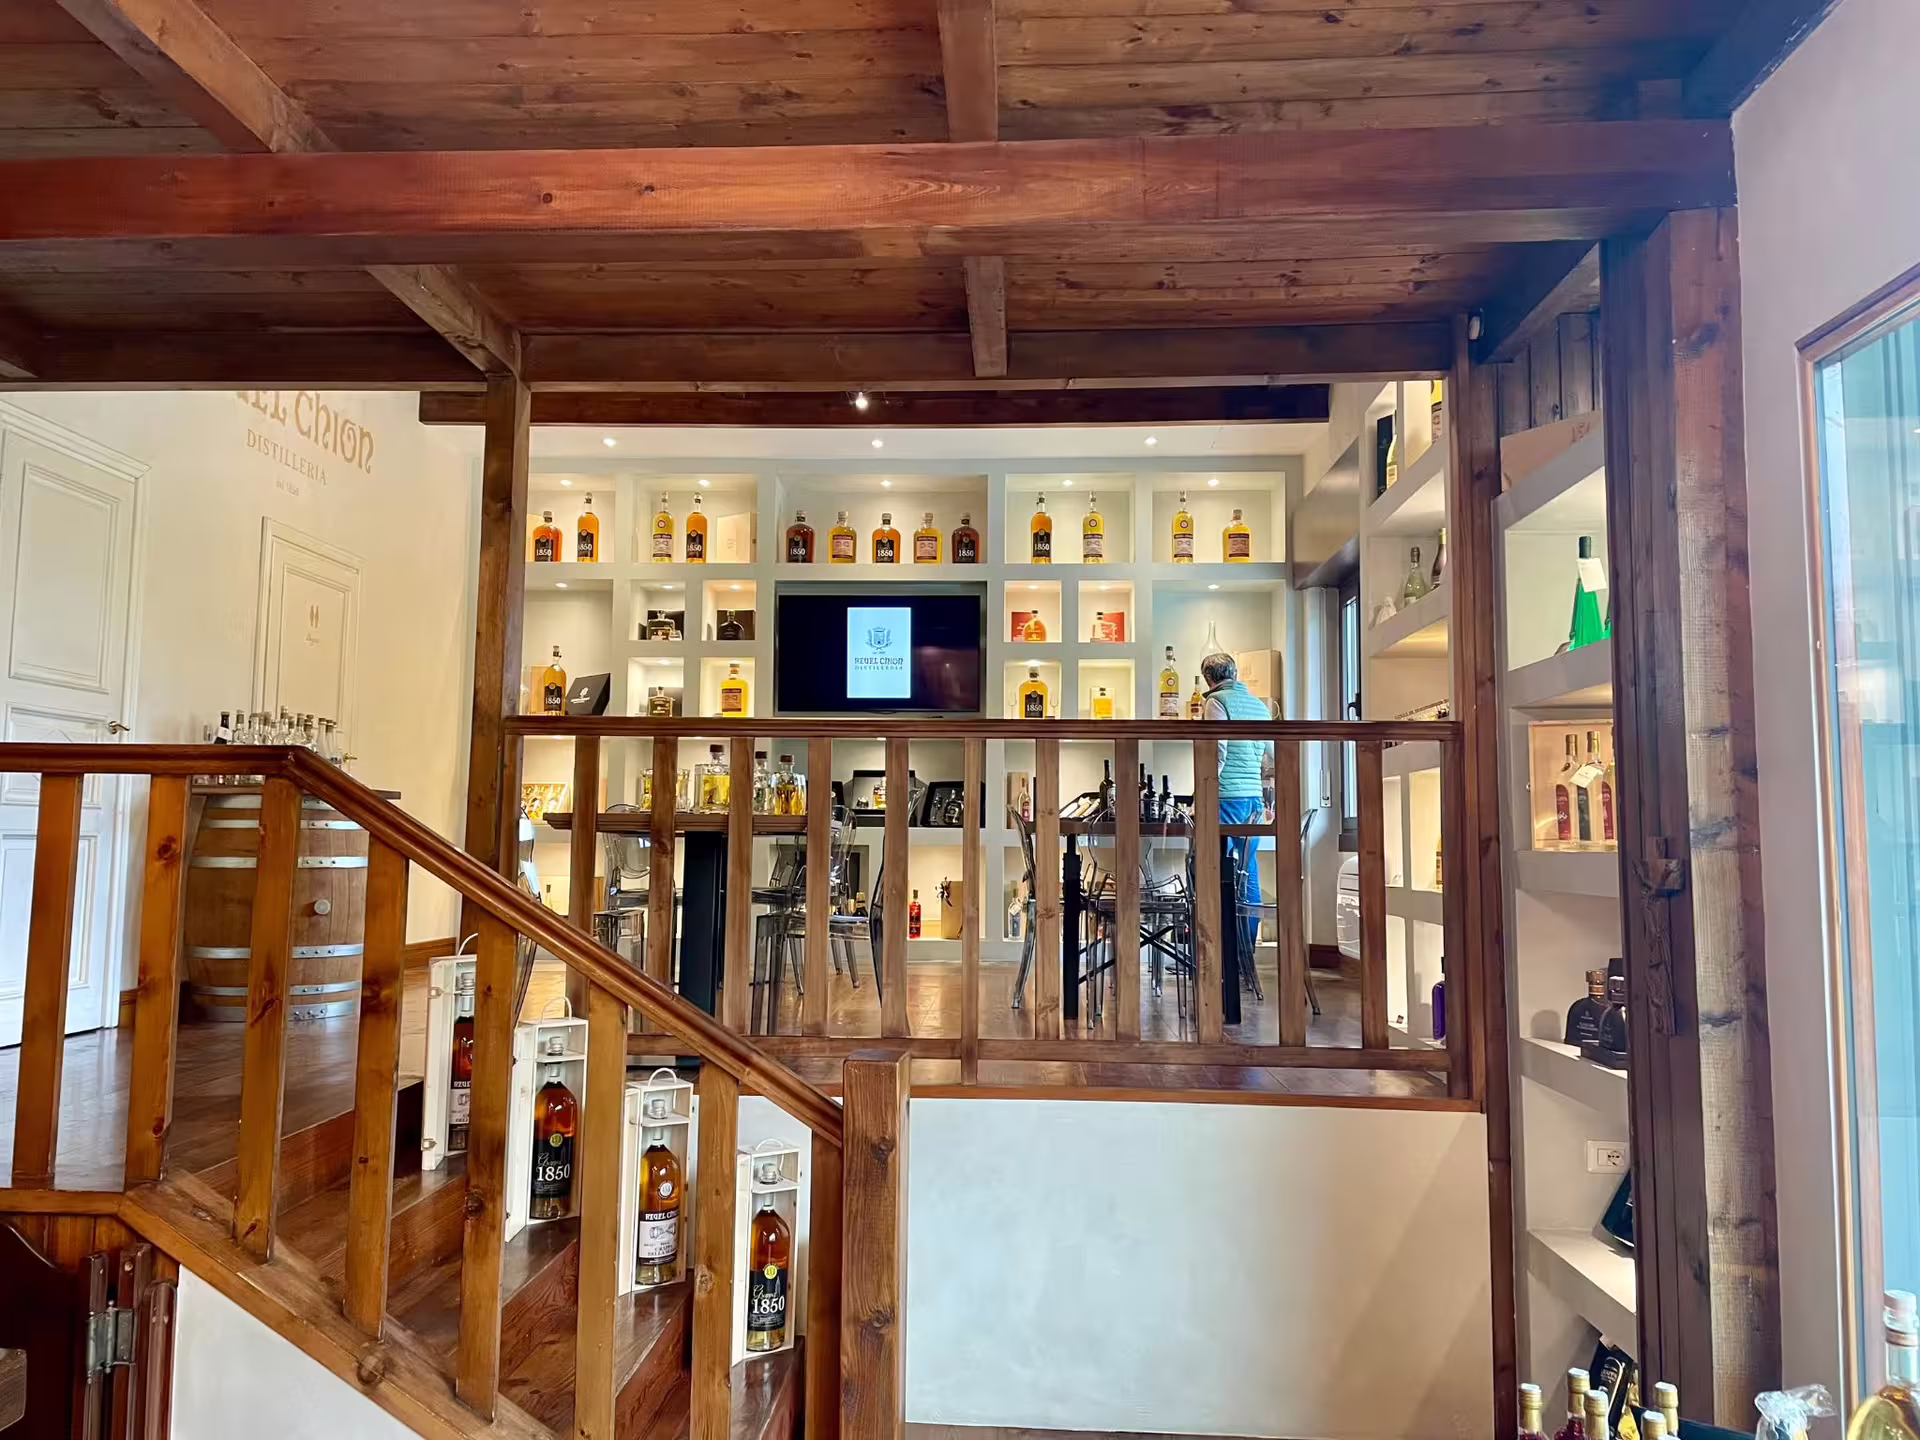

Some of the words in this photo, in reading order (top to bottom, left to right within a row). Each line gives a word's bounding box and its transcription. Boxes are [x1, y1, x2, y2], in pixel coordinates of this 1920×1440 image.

[246, 428, 327, 486] DISTILLERIA
[789, 547, 806, 555] 1850
[877, 549, 893, 557] 1850
[536, 1163, 571, 1182] 1850
[752, 1295, 785, 1314] 1850
